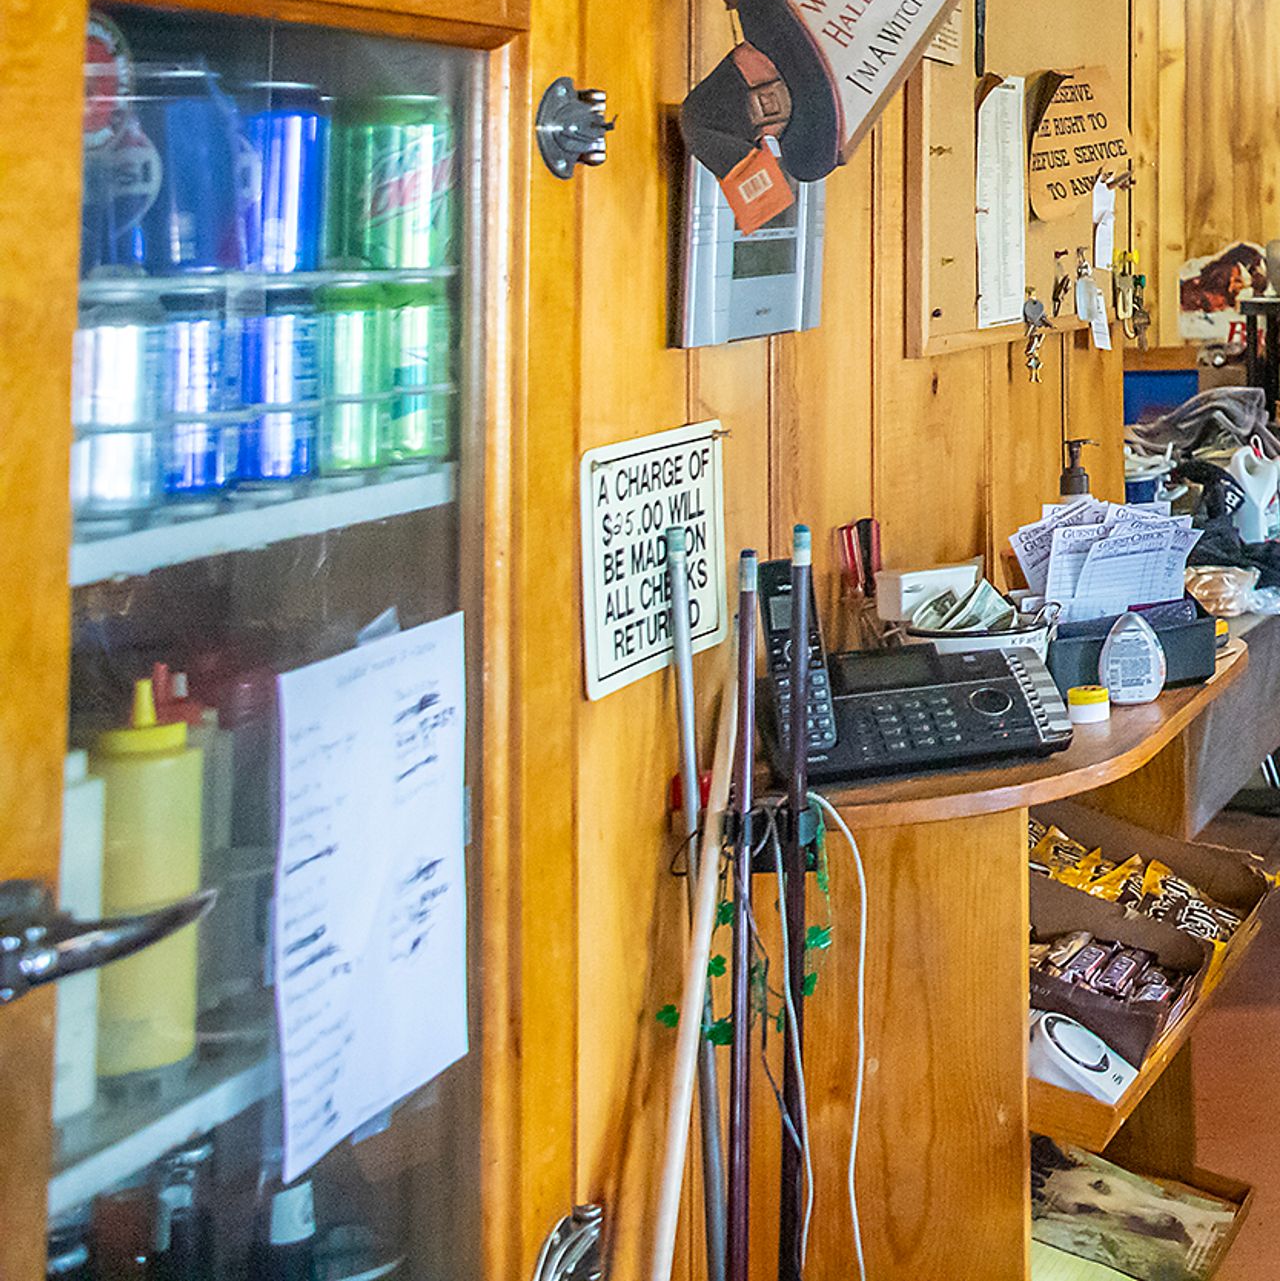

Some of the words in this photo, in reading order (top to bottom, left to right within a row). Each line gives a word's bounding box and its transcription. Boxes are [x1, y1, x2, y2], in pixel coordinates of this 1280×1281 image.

[868, 45, 897, 65] A
[1054, 115, 1086, 136] RIGHT
[1088, 112, 1107, 131] TO
[1074, 139, 1128, 164] SERVICE
[1047, 182, 1067, 201] TO
[597, 475, 610, 507] A
[615, 454, 683, 501] CHARGE
[688, 448, 710, 478] OF
[669, 488, 706, 525] WILL
[603, 549, 625, 586] BE
[631, 535, 668, 576] MAD
[685, 521, 706, 557] ON
[604, 588, 635, 626] ALL
[640, 558, 708, 610] CHEKS
[613, 599, 701, 660] RETURD
